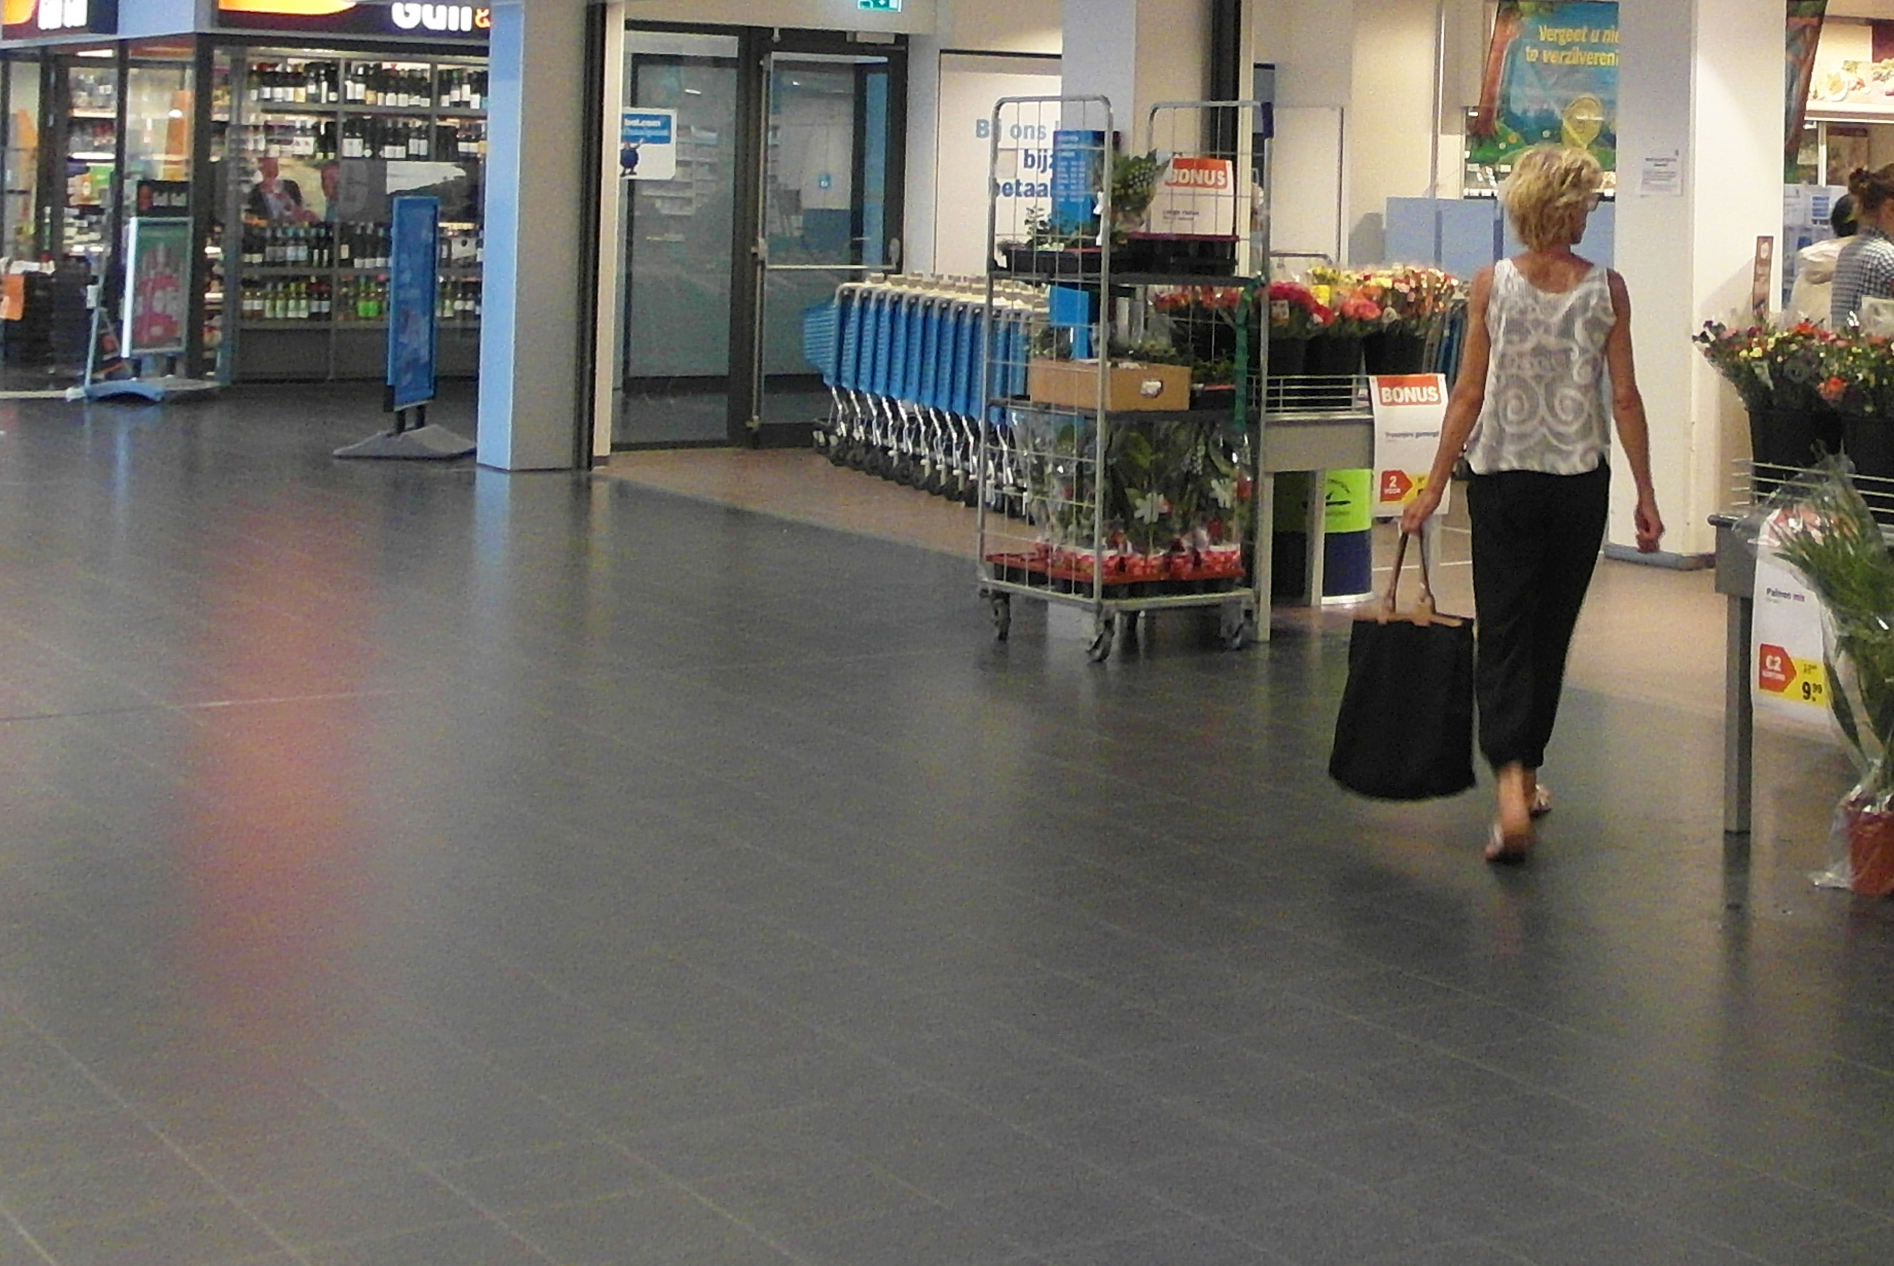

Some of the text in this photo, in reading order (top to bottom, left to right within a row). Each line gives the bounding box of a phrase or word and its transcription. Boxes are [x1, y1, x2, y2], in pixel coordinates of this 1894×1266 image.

[1539, 25, 1588, 46] Vergeet
[1590, 30, 1600, 43] u
[1526, 45, 1539, 63] te
[1009, 123, 1047, 140] ons
[1381, 387, 1439, 403] BONUS
[1389, 475, 1398, 488] 2
